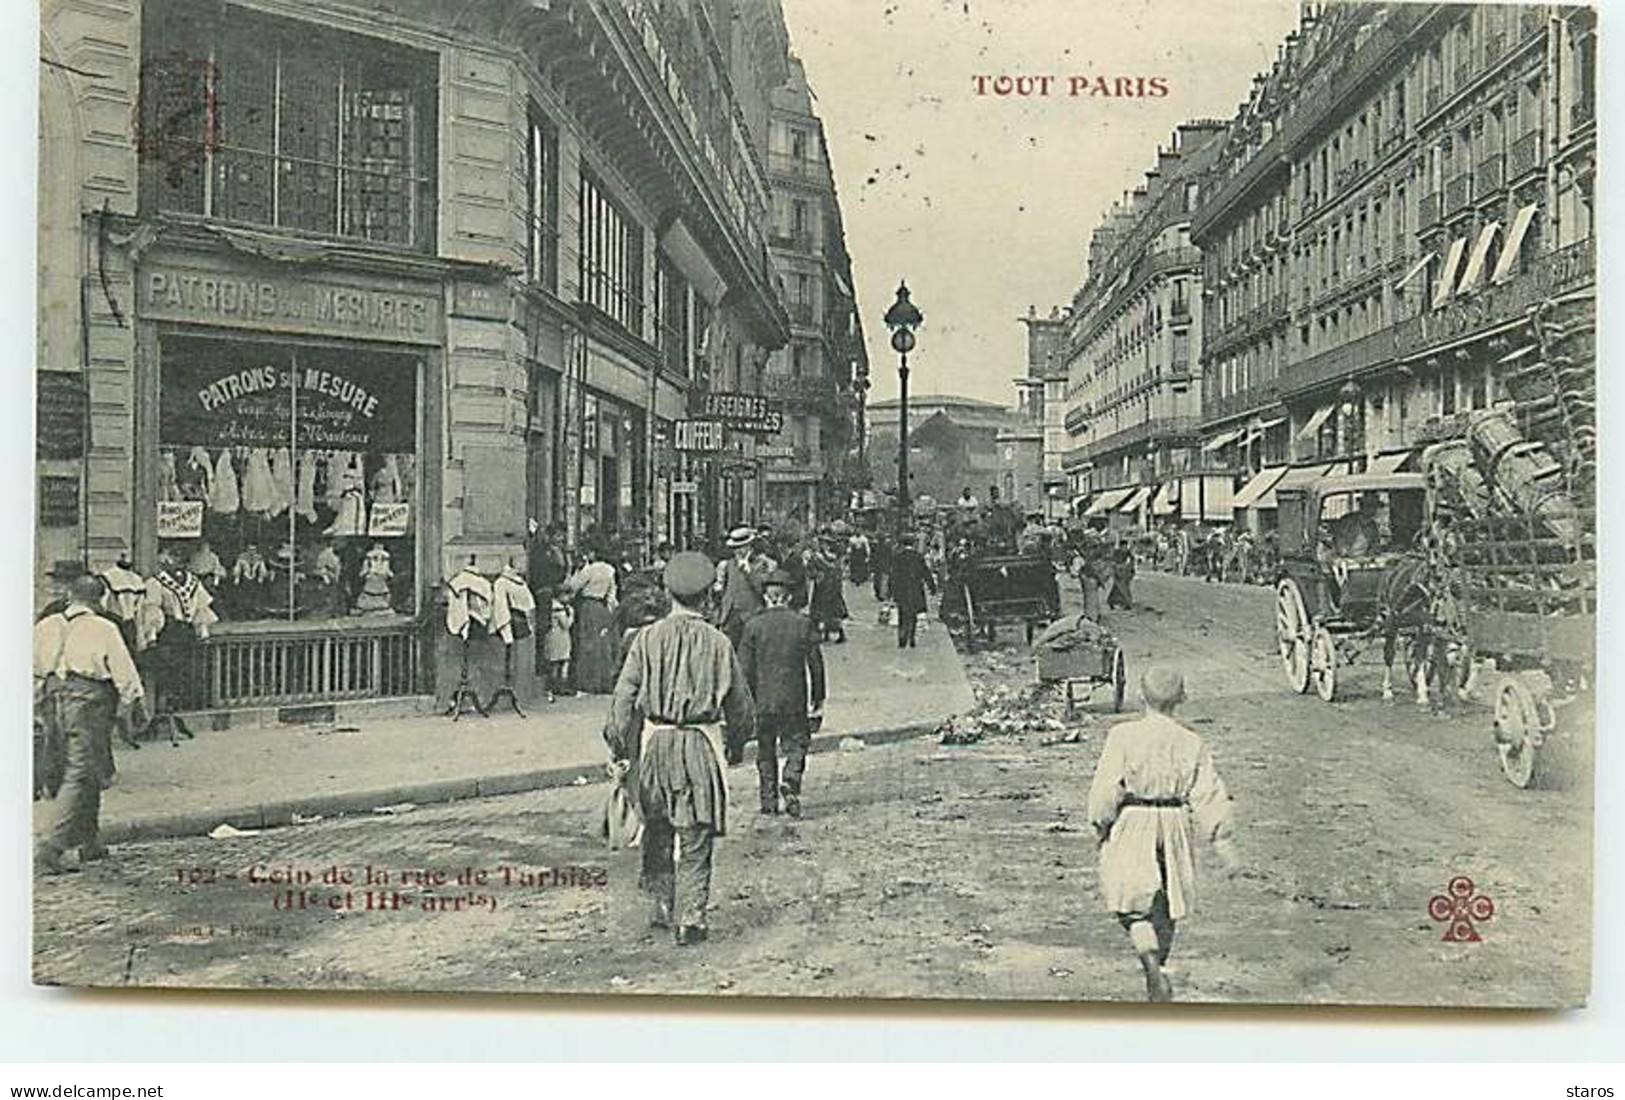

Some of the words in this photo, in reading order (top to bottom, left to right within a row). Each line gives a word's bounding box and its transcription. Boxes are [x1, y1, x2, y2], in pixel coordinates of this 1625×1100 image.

[149, 272, 276, 316] PATRONS
[198, 365, 276, 411] PATRONS
[304, 368, 378, 418] MESURE
